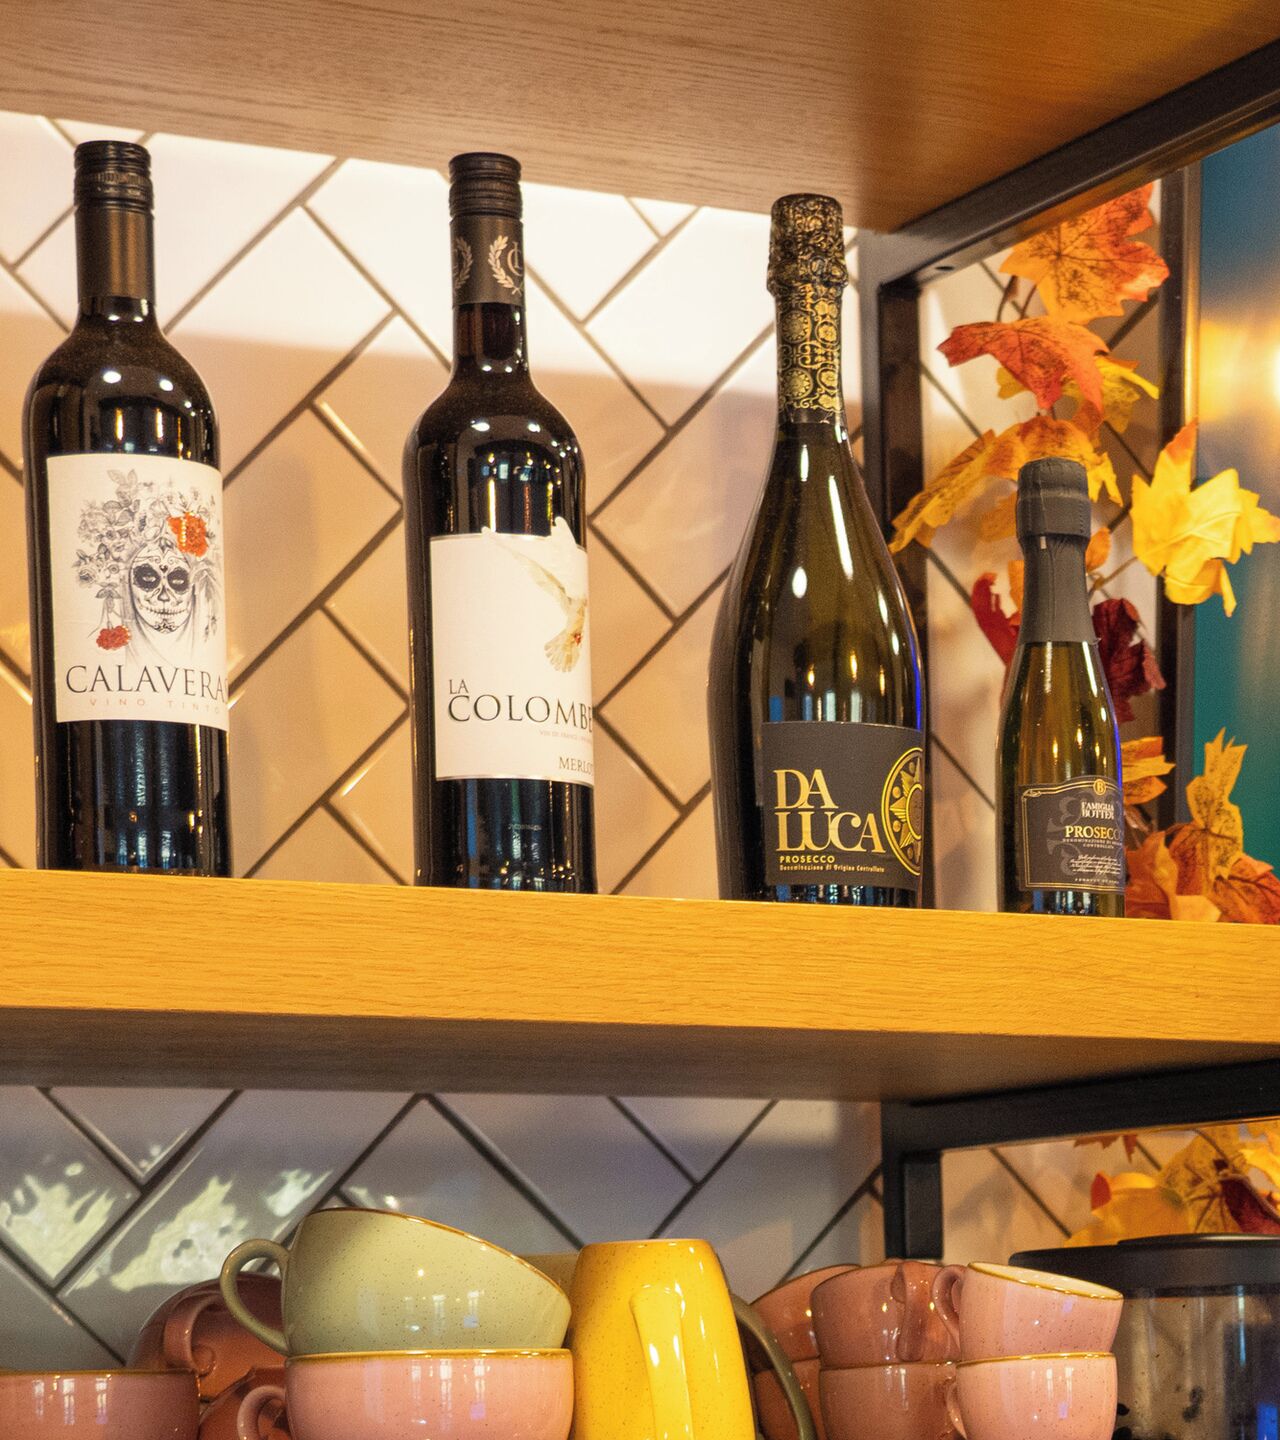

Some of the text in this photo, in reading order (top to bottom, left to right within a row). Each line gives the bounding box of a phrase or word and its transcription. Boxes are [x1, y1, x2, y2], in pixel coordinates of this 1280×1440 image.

[448, 679, 469, 695] LA
[773, 768, 839, 809] DA
[774, 811, 887, 854] LUCA
[779, 855, 836, 864] PROSECCO
